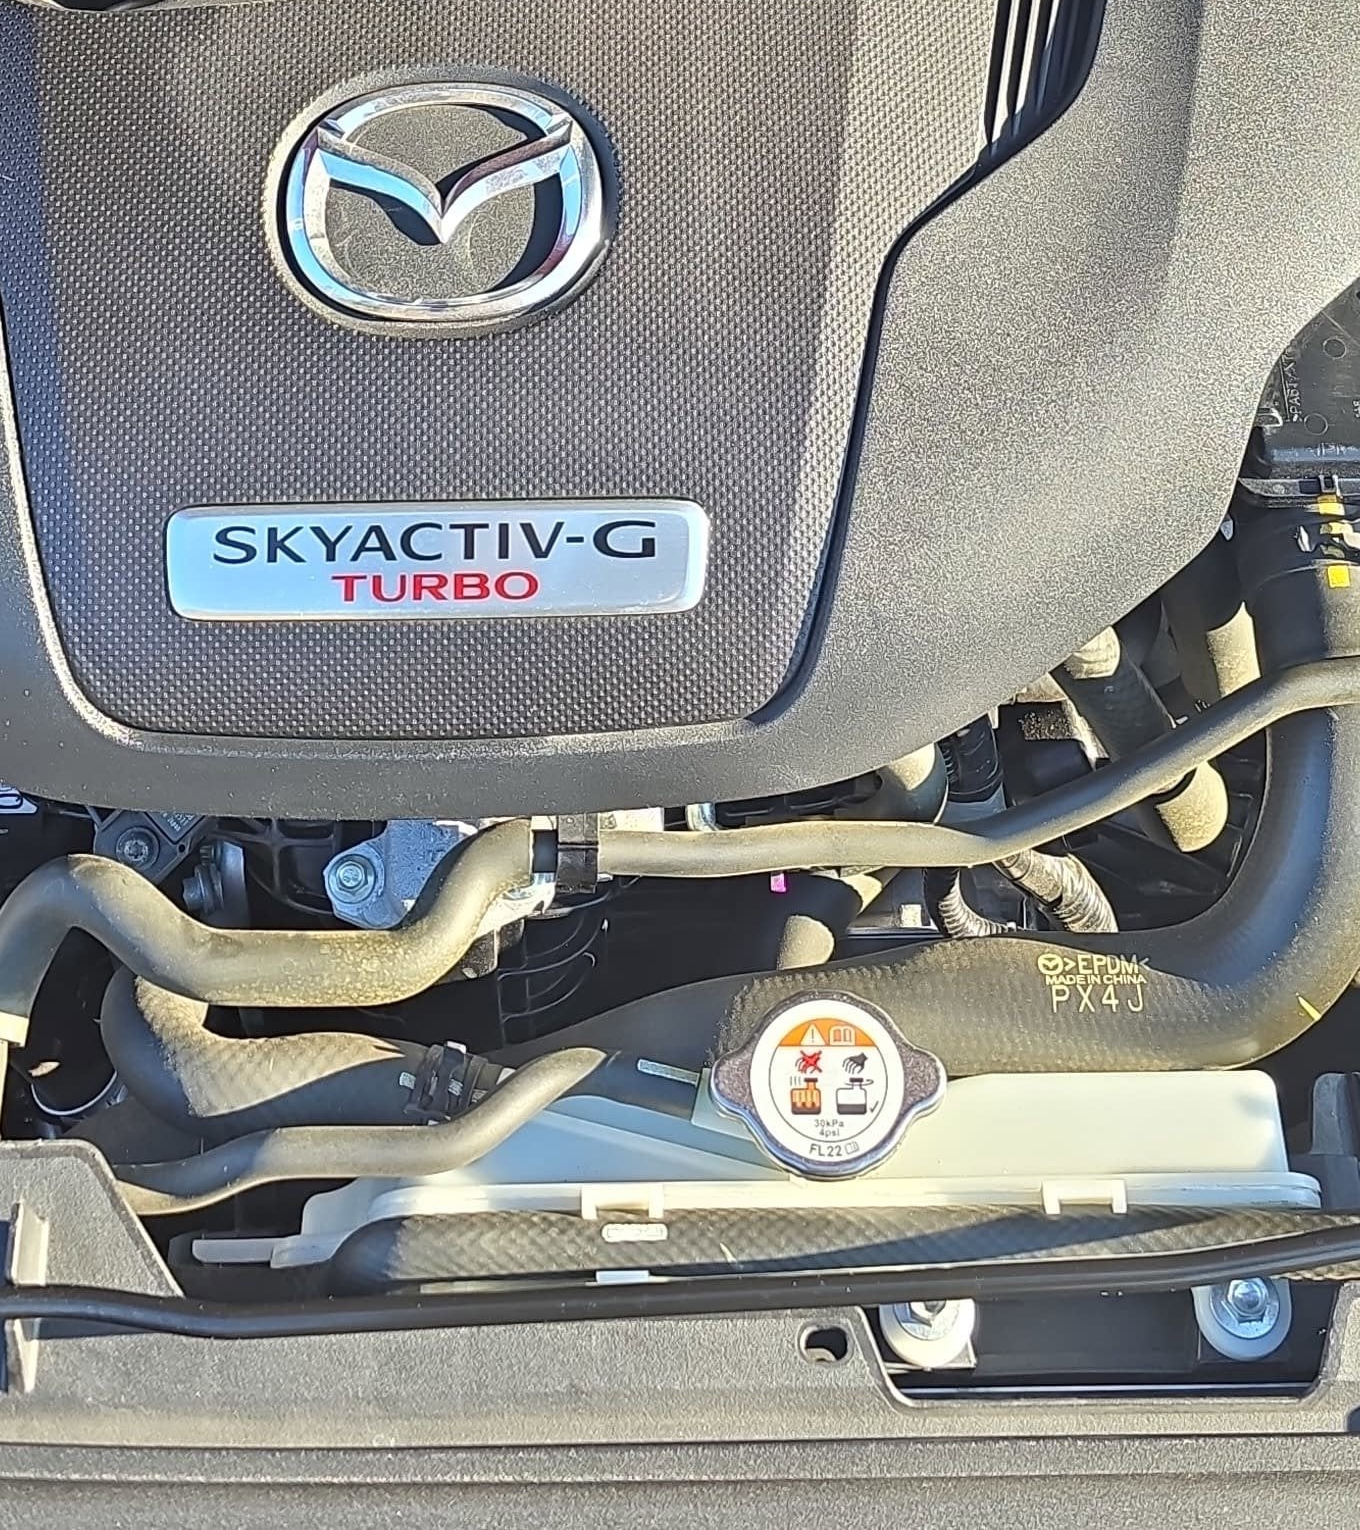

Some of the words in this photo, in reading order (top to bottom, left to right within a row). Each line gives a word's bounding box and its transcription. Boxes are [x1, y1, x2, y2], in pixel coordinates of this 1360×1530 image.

[212, 520, 657, 566] SKYACTIV-G
[330, 571, 540, 603] TURBO
[1045, 975, 1085, 985] MADE
[1087, 974, 1102, 985] IN
[1104, 974, 1147, 985] CHINA
[814, 1118, 845, 1129] 30kPa
[819, 1127, 840, 1138] 4psi
[808, 1144, 843, 1158] FL22
